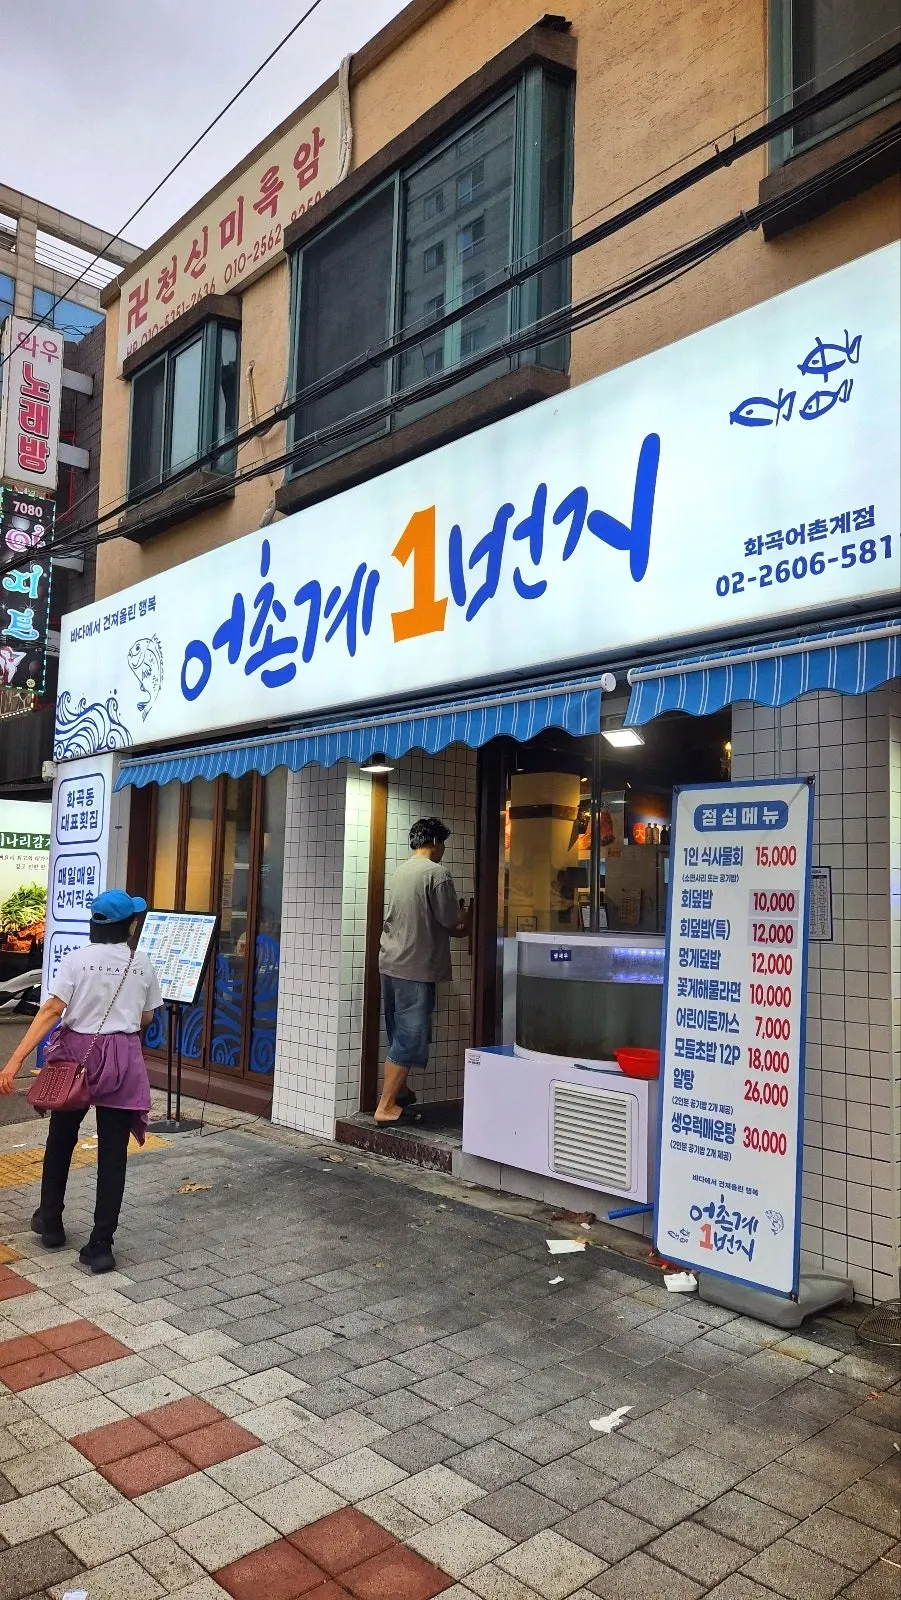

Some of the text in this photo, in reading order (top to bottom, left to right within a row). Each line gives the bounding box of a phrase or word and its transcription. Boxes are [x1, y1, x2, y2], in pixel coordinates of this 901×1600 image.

[16, 332, 60, 364] 와우
[19, 361, 52, 474] 노래방
[13, 501, 43, 518] 7080
[743, 505, 875, 557] 화곡어촌계점
[715, 533, 901, 597] 02-2606-581
[70, 595, 156, 643] 바다에서 건져올린 행복
[180, 539, 380, 701] 어촌계
[66, 787, 95, 809] 화곡동
[60, 810, 99, 831] 대표횟집
[683, 845, 797, 868] 1인 식사물회 15,000
[57, 866, 95, 886] 매일매일
[681, 889, 795, 912] 회덮밥 10,000
[680, 918, 794, 943] 회덮밥(특) 12,000
[679, 948, 793, 976] 멍게덮밥 12,000
[677, 977, 792, 1008] 꽃게해물라면 10,000
[676, 1006, 791, 1041] 어린이돈까스 7,000
[674, 1037, 790, 1074] 모듬초밥 12P 18,000
[673, 1067, 789, 1108] 알탕 26,000
[690, 1098, 708, 1111] 공기밥
[708, 1102, 719, 1113] 2개
[718, 1104, 734, 1116] 제공)
[671, 1111, 787, 1156] 생우럭매운탕 30,000
[688, 1143, 706, 1156] 공기밥
[706, 1147, 717, 1159] 2개
[717, 1150, 732, 1162] 제공)
[692, 1174, 717, 1187] 바다에서
[689, 1194, 759, 1235] 어촌계
[699, 1224, 755, 1262] 1번지
